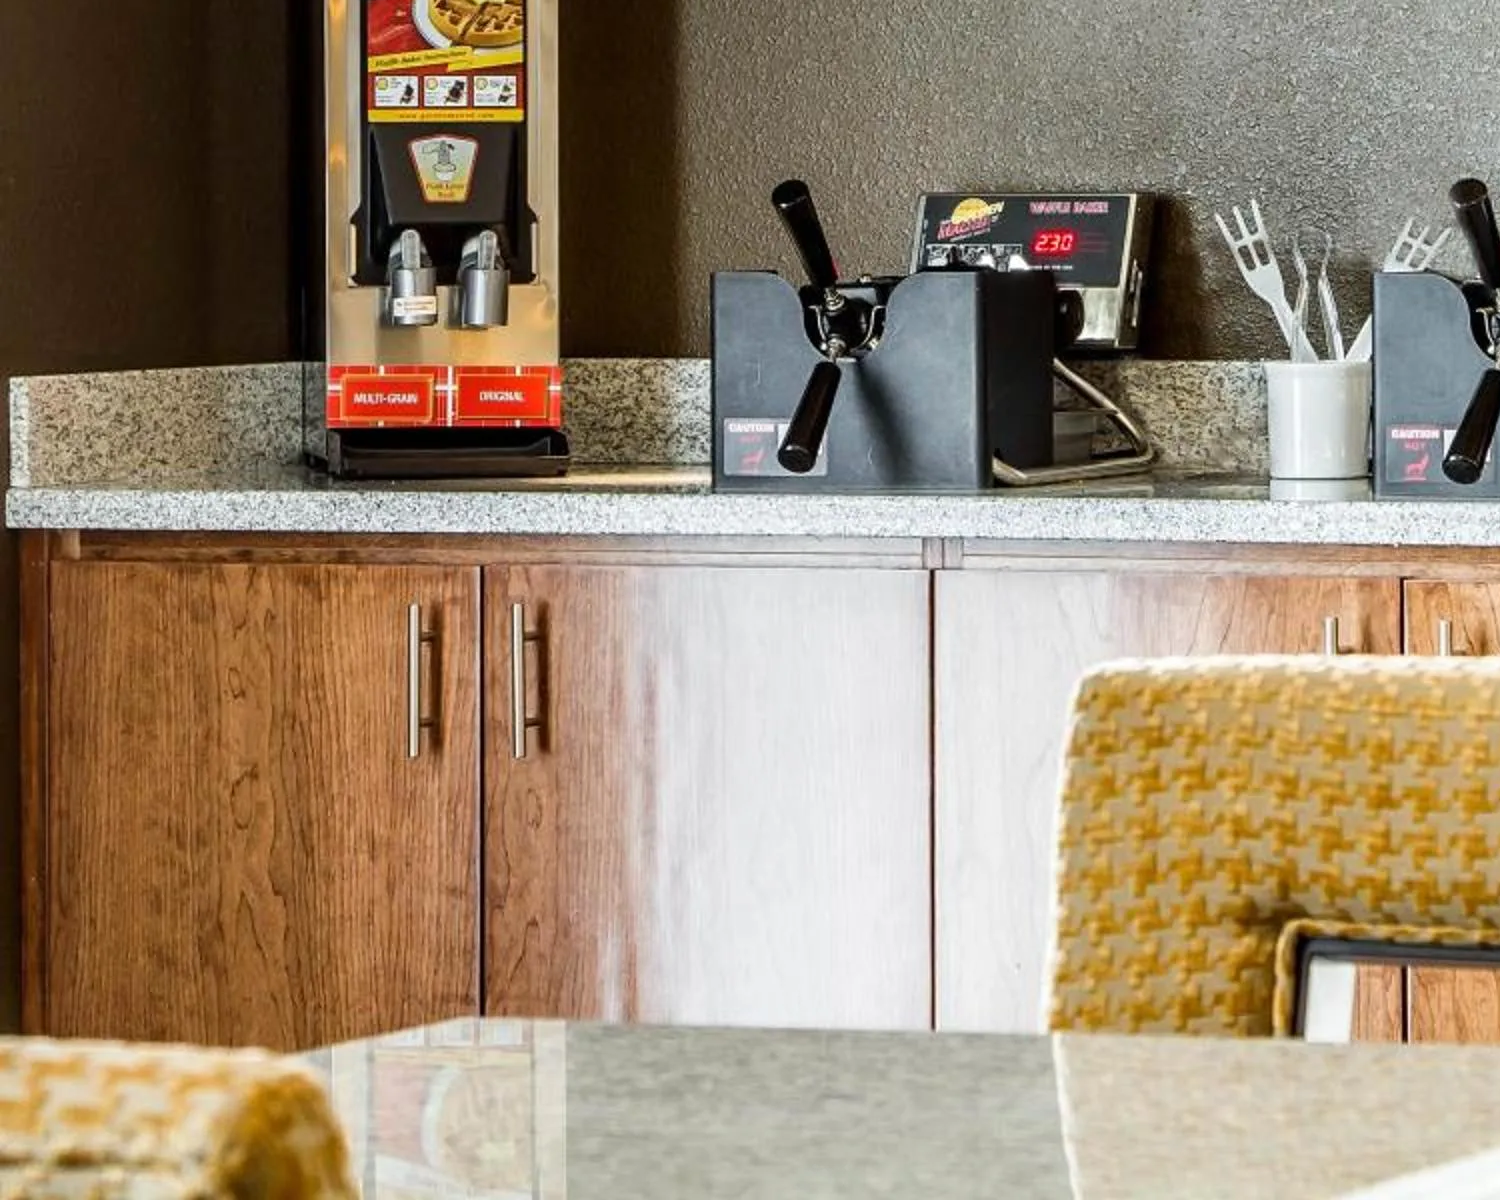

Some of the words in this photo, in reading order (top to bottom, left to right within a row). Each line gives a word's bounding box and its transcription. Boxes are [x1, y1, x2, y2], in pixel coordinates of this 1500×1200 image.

[1034, 234, 1074, 252] 230
[354, 391, 419, 405] MULTI-GRAIN
[479, 391, 525, 402] ORIGINAL
[728, 423, 775, 433] CAUTION
[1391, 429, 1440, 439] CAUTION
